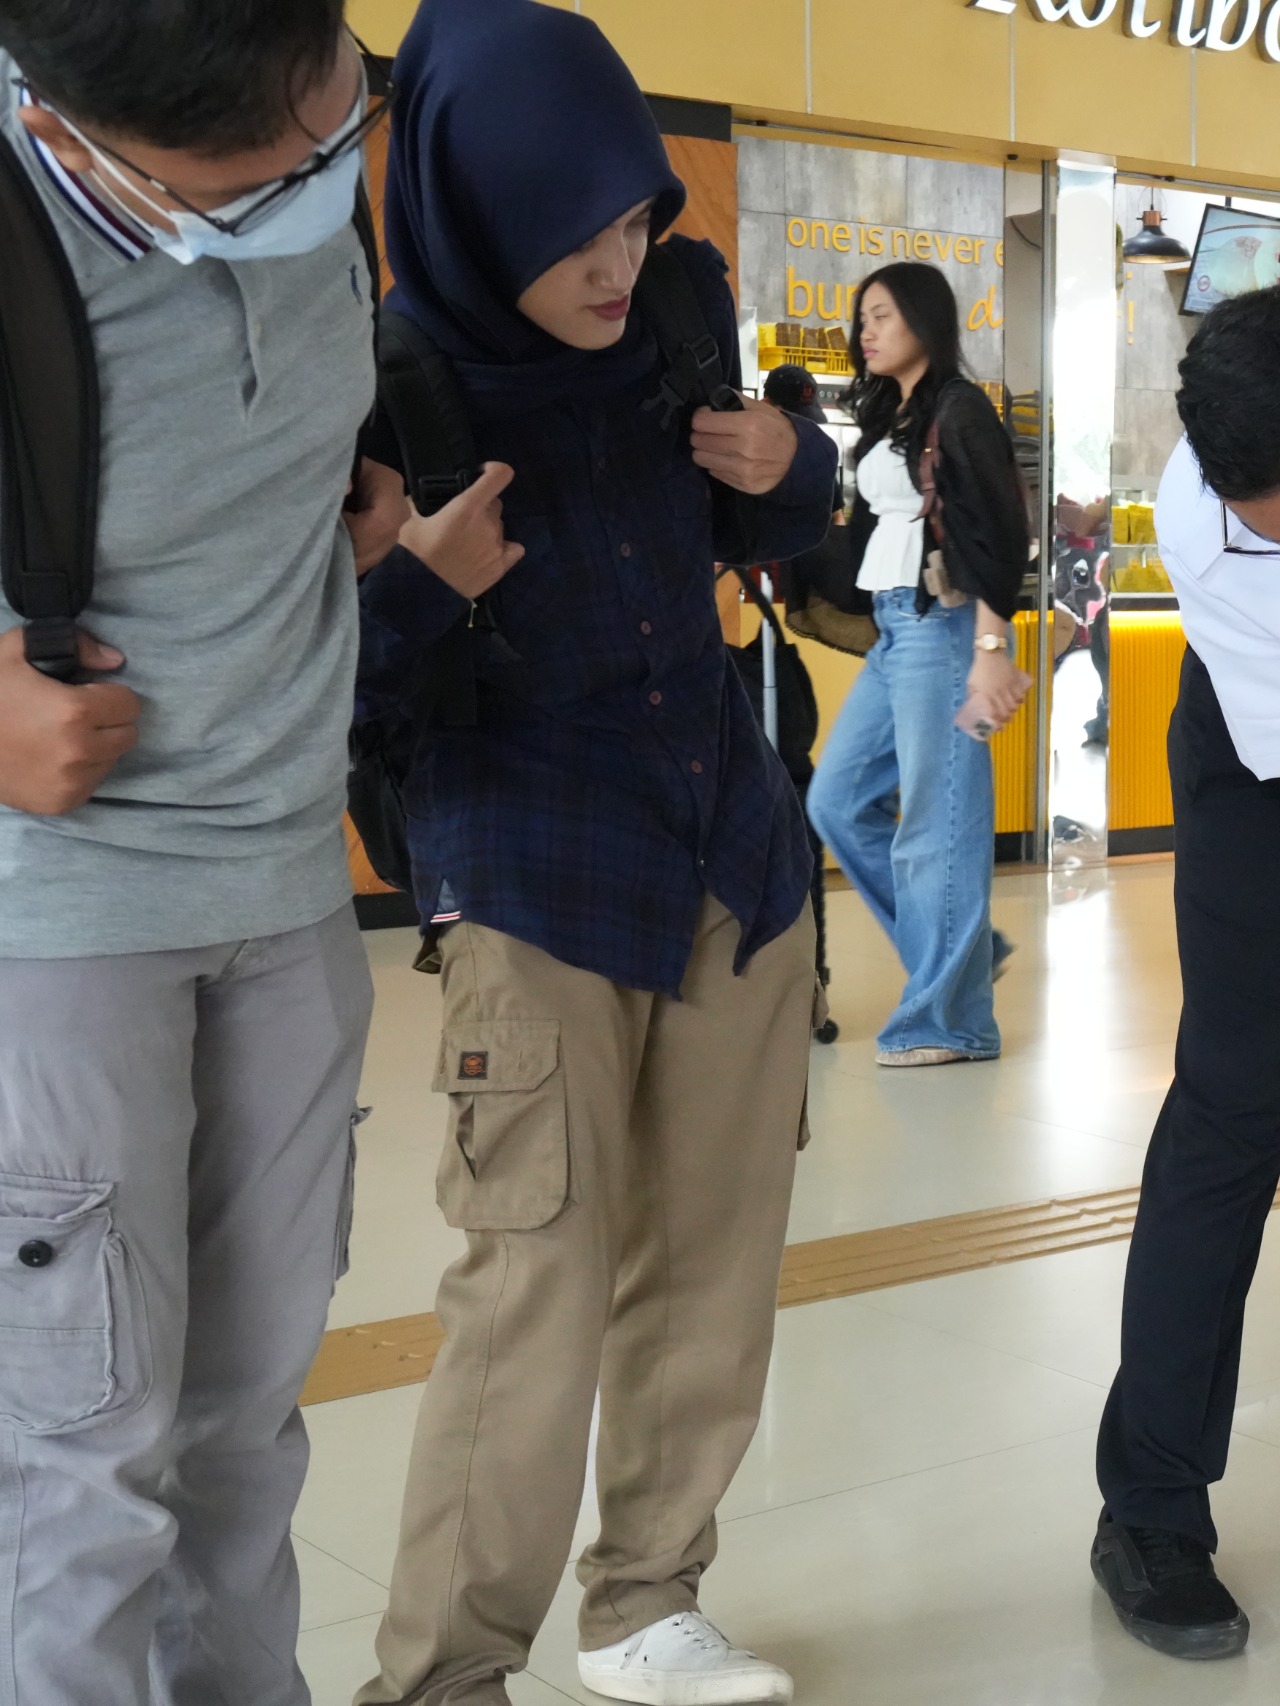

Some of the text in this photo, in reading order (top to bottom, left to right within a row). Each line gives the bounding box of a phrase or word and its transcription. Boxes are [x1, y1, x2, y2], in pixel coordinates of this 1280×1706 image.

[787, 216, 852, 253] one
[858, 217, 885, 256] is
[892, 228, 986, 265] never
